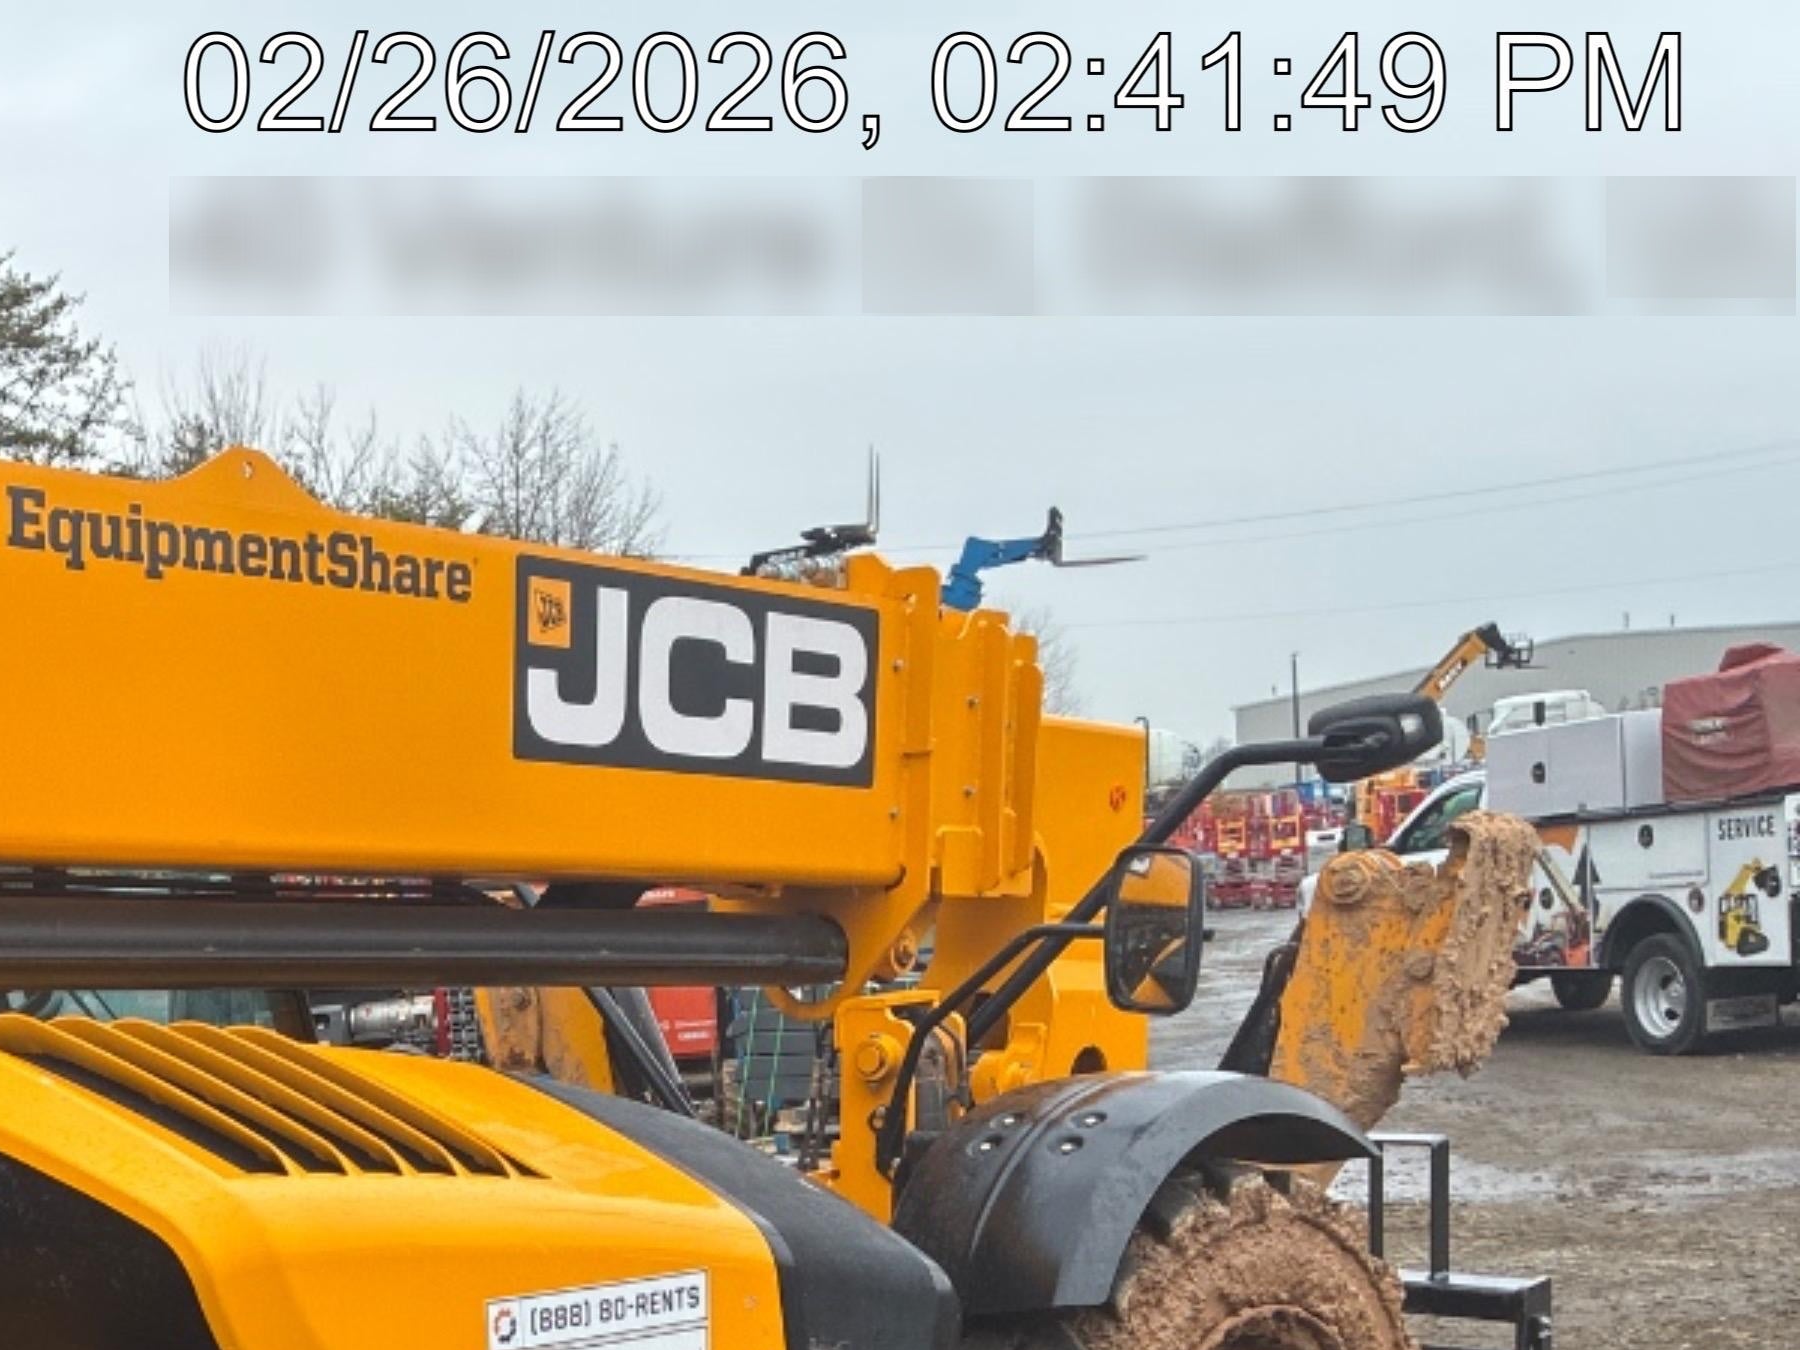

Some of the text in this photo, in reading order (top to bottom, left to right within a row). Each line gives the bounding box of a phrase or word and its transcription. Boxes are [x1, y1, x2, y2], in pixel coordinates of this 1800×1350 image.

[6, 484, 472, 604] EquipmentShare
[526, 586, 870, 770] JCB
[1718, 814, 1776, 840] SERVICE
[530, 1300, 592, 1336] (888)
